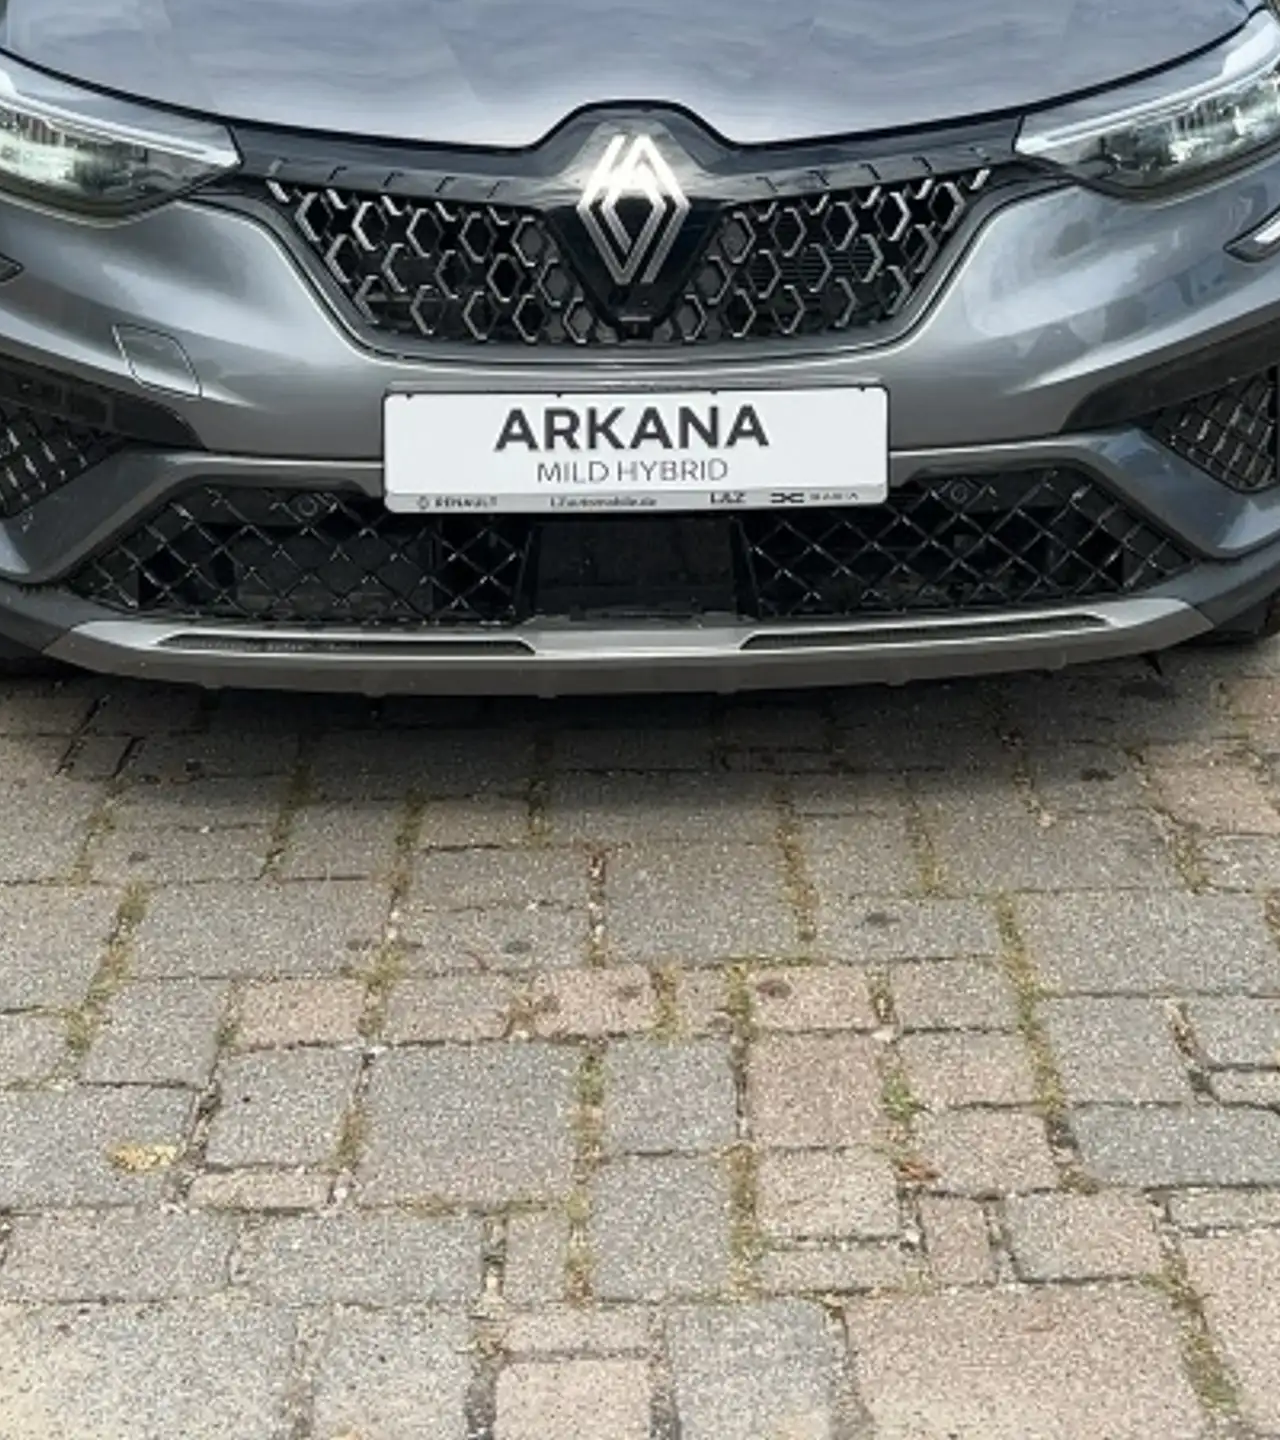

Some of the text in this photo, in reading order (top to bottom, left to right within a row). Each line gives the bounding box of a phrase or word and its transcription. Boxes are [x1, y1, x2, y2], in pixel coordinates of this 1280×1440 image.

[493, 403, 771, 453] ARKANA
[536, 457, 729, 484] MILD HYBRID
